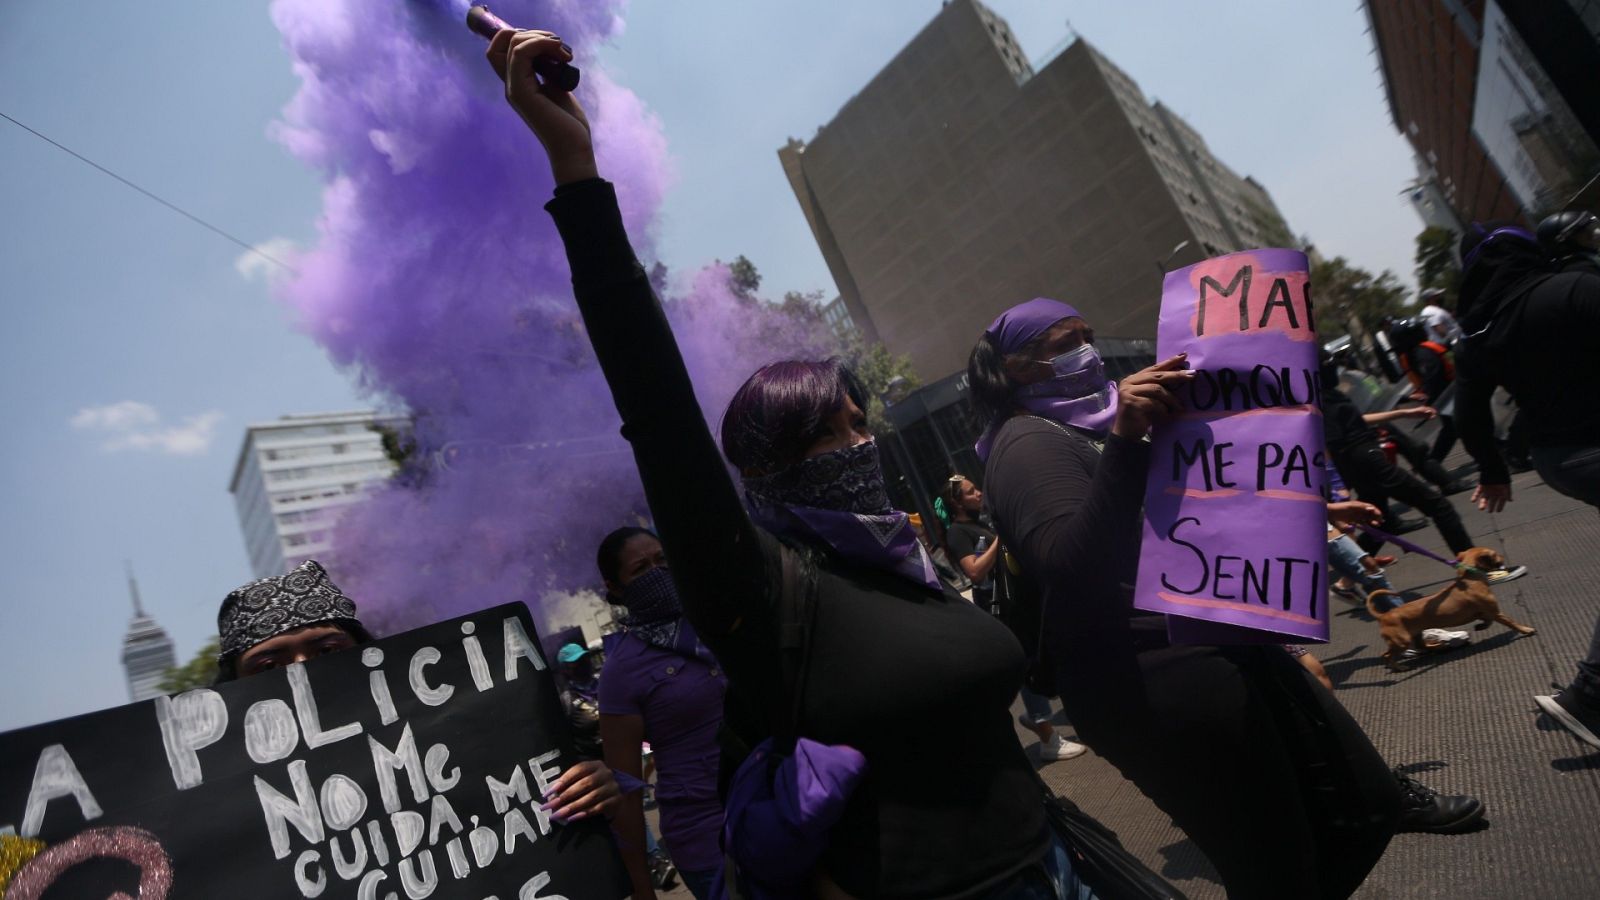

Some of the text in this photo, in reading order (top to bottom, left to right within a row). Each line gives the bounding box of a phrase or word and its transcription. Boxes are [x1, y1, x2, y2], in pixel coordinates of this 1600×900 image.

[1172, 361, 1322, 411] ORQU
[1172, 438, 1236, 491] ME
[1160, 517, 1320, 619] SENTI
[0, 743, 104, 839] A
[253, 760, 368, 860] NO
[485, 748, 562, 814] ME
